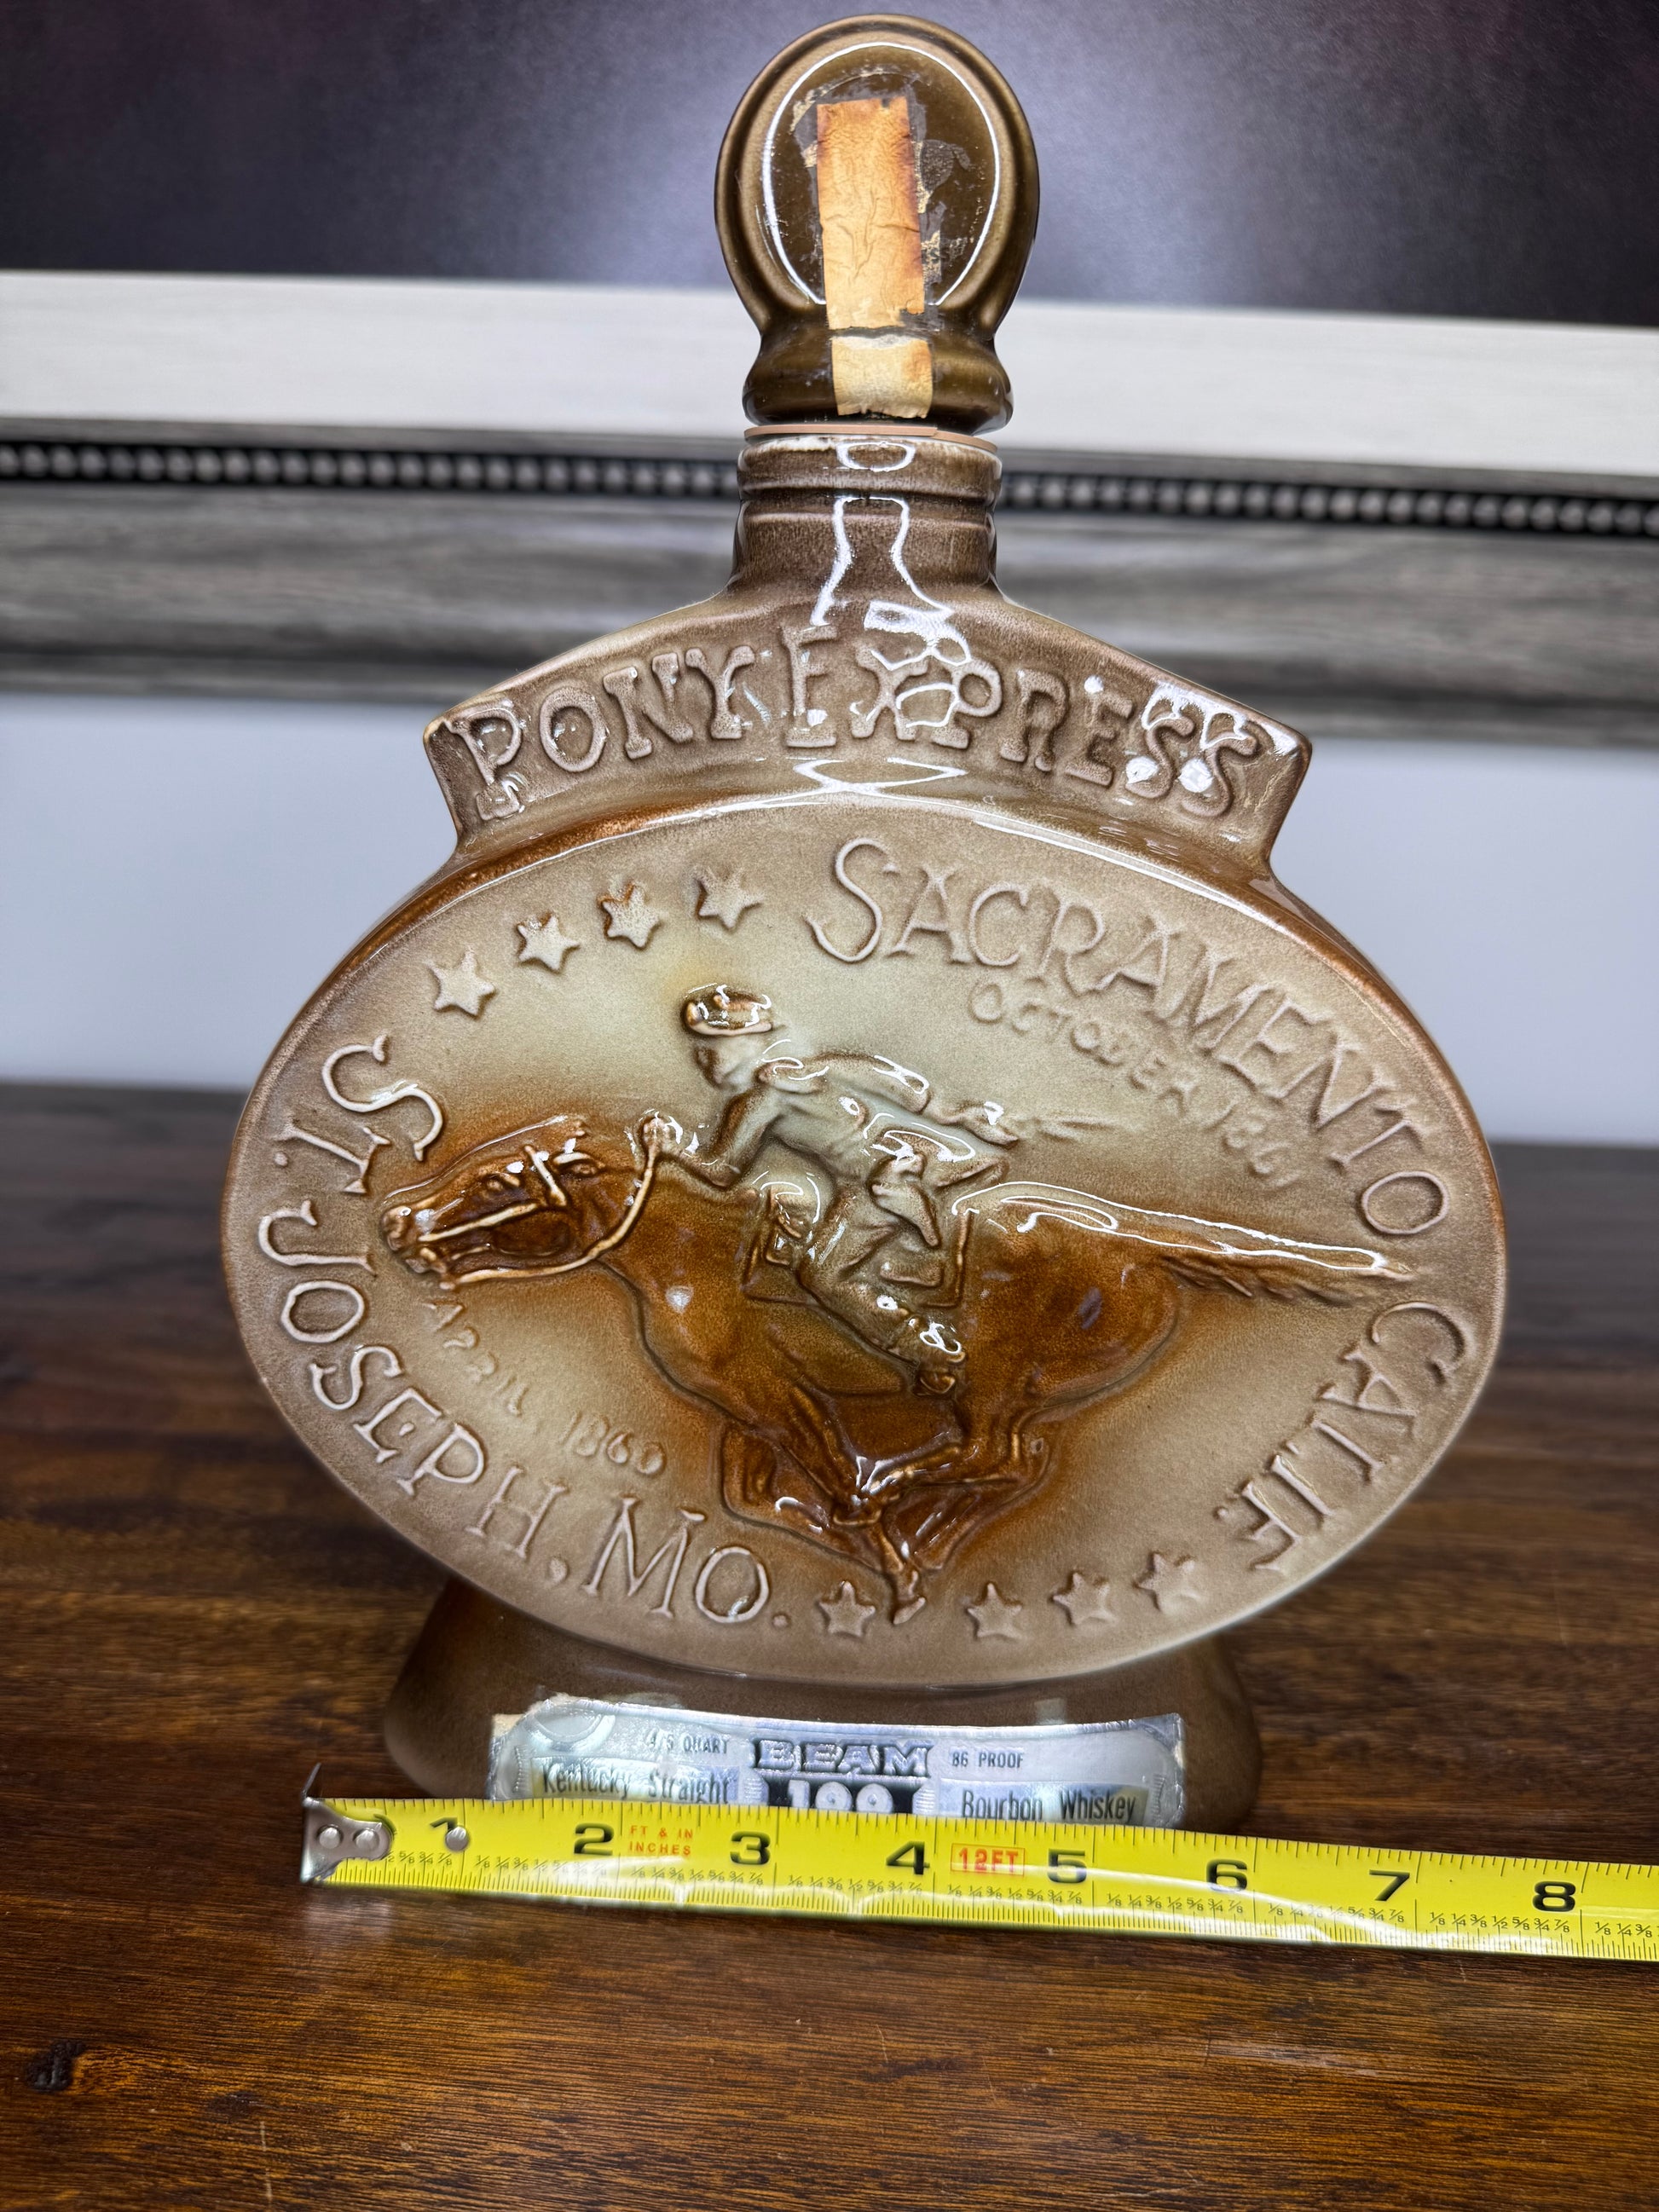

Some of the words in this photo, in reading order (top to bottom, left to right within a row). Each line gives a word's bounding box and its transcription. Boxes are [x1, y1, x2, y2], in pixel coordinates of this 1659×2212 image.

[452, 645, 755, 823] PONY
[779, 622, 1265, 818] EXPRESS
[803, 837, 1450, 1236] SACRAMENTO
[682, 1733, 731, 1755] QUART
[754, 1738, 935, 1777] BEAM
[951, 1750, 969, 1768] 86
[978, 1752, 1024, 1770] PROOF
[541, 1761, 632, 1800] Kentucky
[648, 1767, 732, 1805] Straight
[962, 1789, 1044, 1822] Bourbon
[1059, 1790, 1136, 1825] Whiskey
[629, 1840, 691, 1857] INCHES
[630, 1825, 649, 1836] FT
[658, 1827, 668, 1839] &
[678, 1828, 694, 1839] IN
[573, 1822, 615, 1857] 2
[730, 1830, 772, 1865] 3
[886, 1840, 930, 1875] 4
[958, 1846, 1020, 1874] 12FT
[1047, 1848, 1087, 1885] 5
[1206, 1858, 1248, 1893] 6
[1368, 1868, 1411, 1902] 7
[1532, 1880, 1576, 1913] 8
